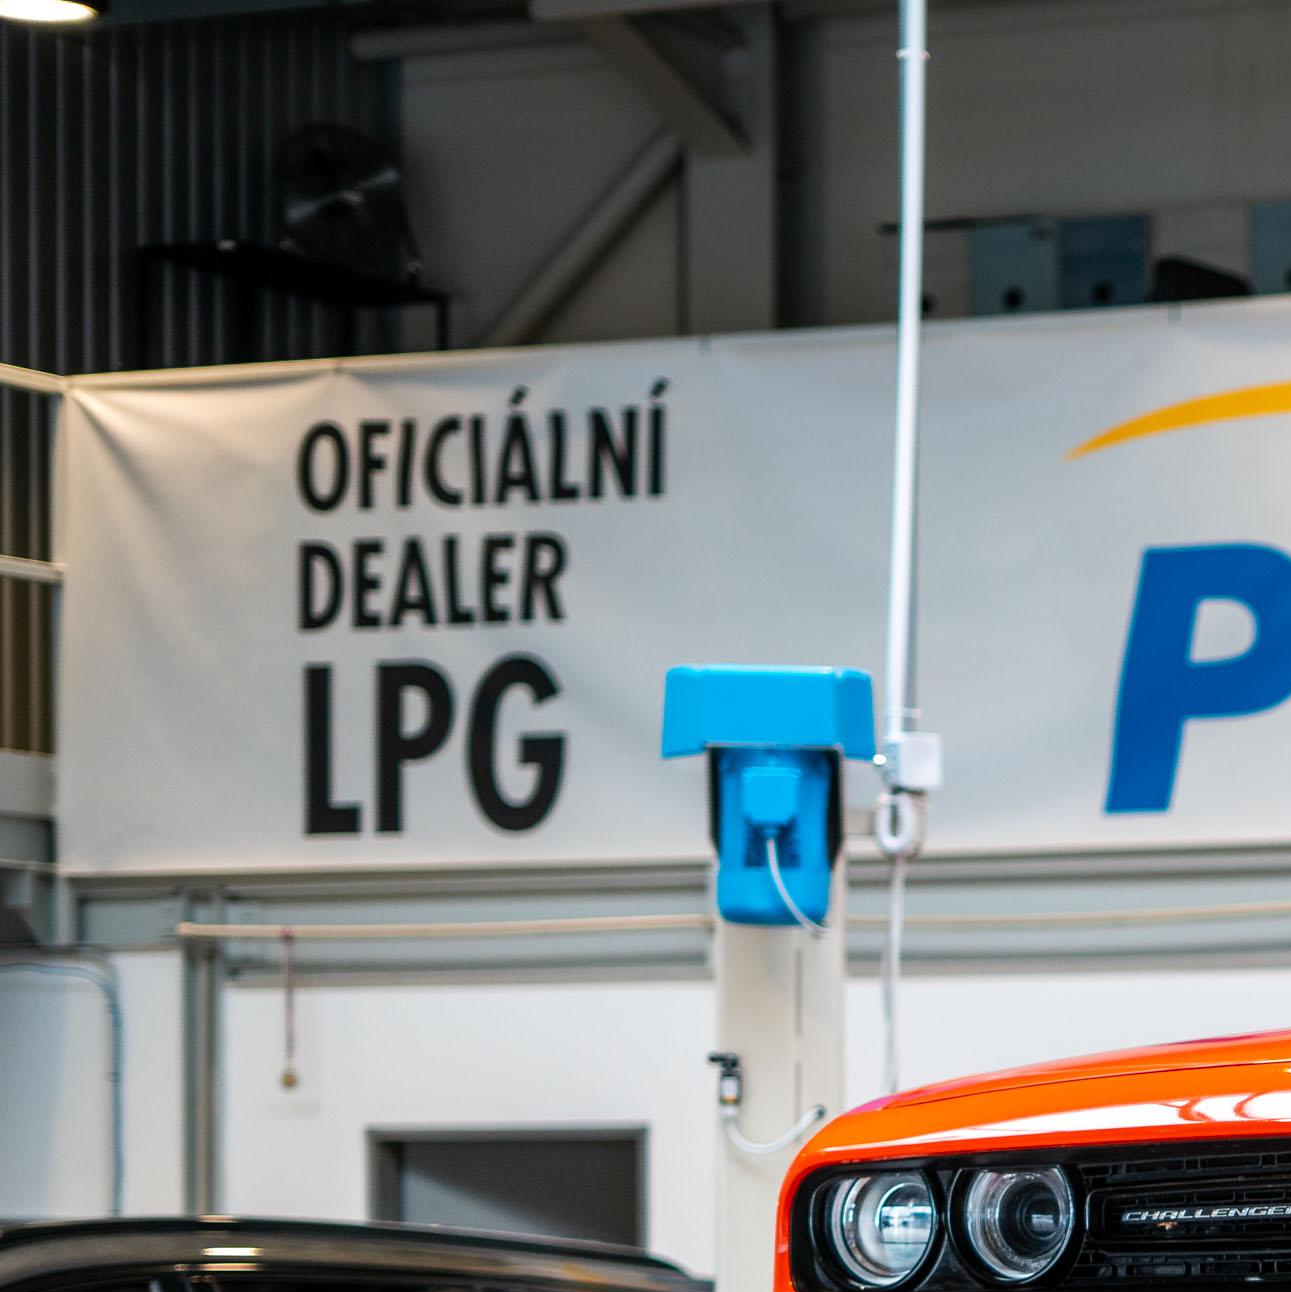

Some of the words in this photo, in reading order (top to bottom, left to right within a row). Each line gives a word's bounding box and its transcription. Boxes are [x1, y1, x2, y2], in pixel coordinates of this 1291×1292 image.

[297, 379, 670, 512] OFICIÁLNÍ
[298, 532, 567, 630] DEALER
[302, 652, 567, 836] LPG
